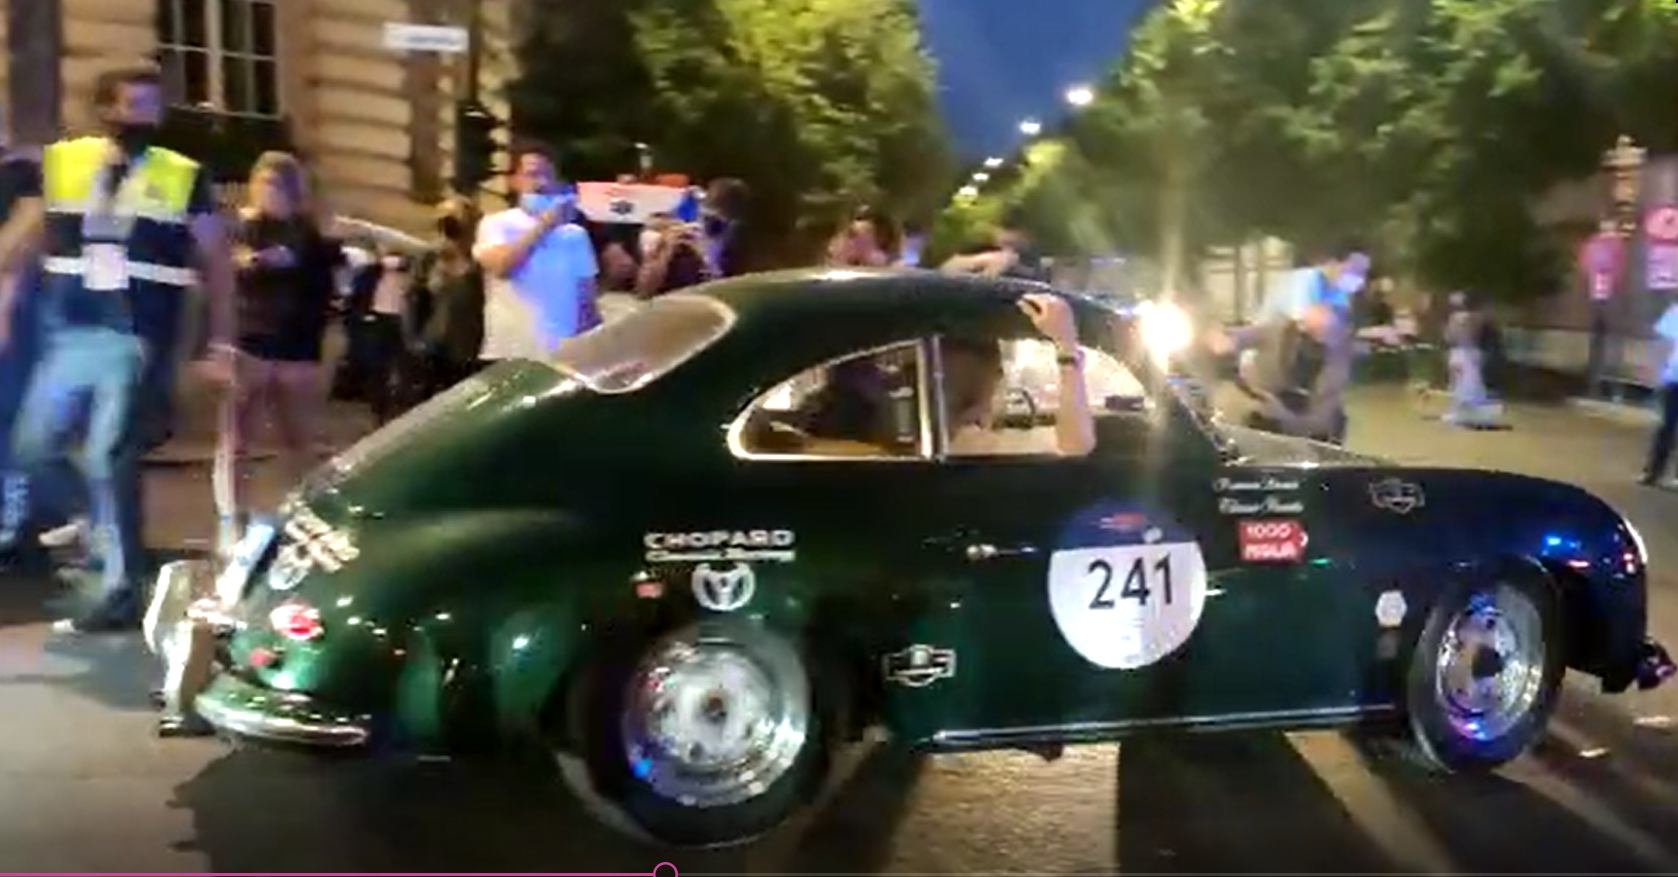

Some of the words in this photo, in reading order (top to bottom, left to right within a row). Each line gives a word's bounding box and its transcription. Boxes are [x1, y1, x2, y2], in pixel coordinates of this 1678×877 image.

[643, 529, 796, 548] CHOPARD
[1246, 523, 1291, 538] 1000
[1088, 552, 1173, 609] 241
